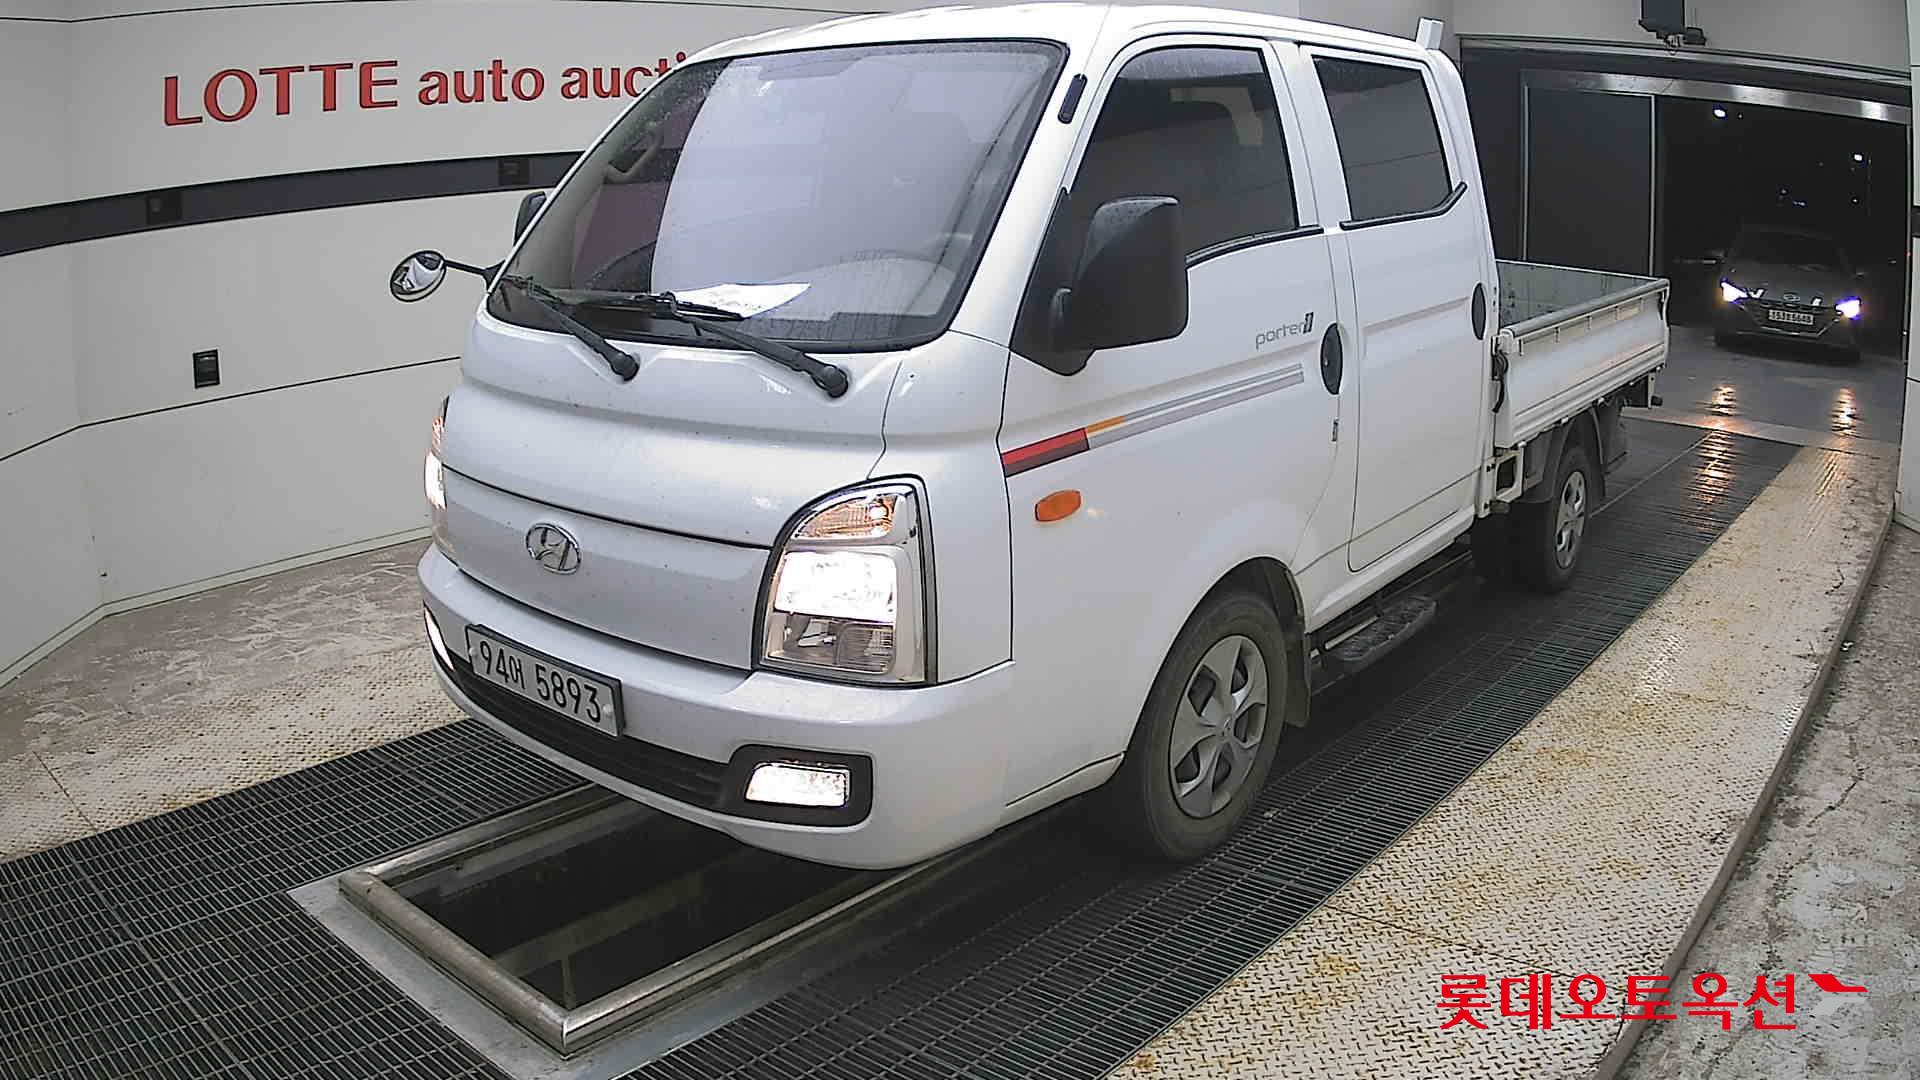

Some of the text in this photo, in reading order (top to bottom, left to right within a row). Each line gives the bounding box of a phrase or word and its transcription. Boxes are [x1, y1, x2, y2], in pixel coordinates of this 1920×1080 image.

[164, 60, 398, 126] LOTTE
[417, 59, 546, 106] auto
[535, 664, 601, 723] 5893
